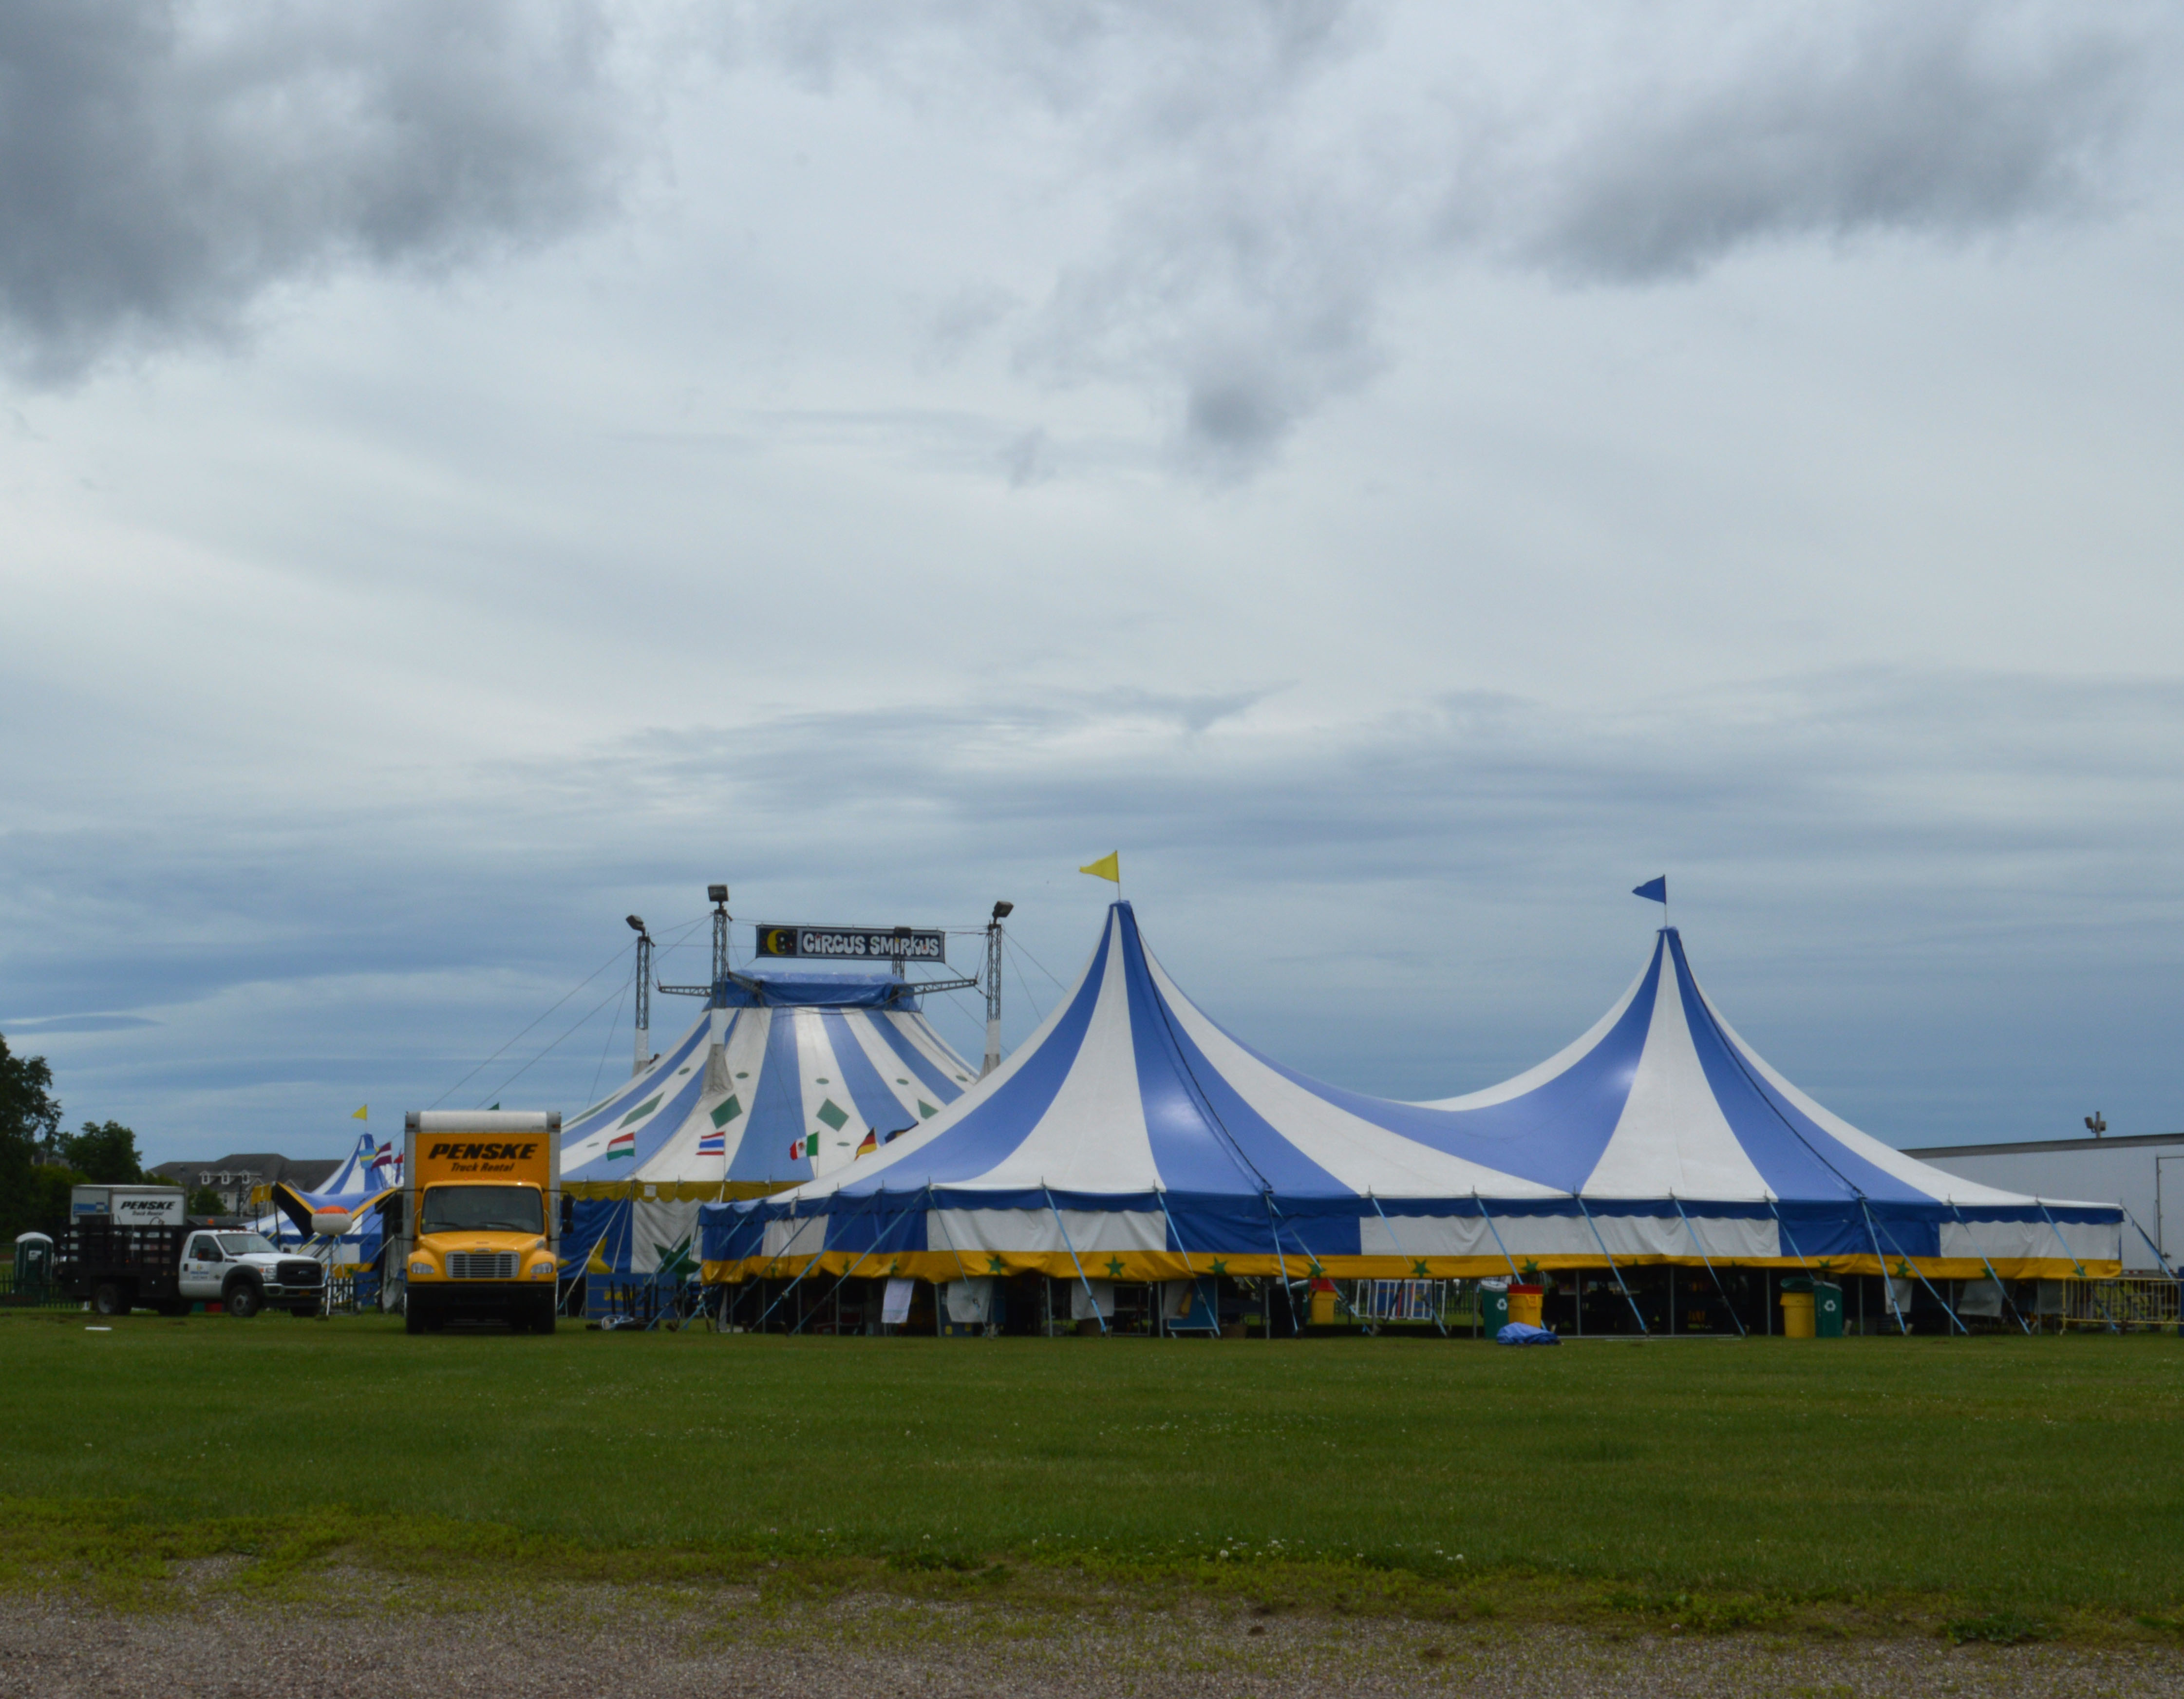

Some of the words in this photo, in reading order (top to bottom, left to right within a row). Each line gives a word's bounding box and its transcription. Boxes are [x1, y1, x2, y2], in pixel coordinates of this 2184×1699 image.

[428, 1143, 538, 1159] PENSKE
[451, 1162, 478, 1172] Truck
[480, 1162, 515, 1172] Rental
[120, 1201, 176, 1209] PENSKE
